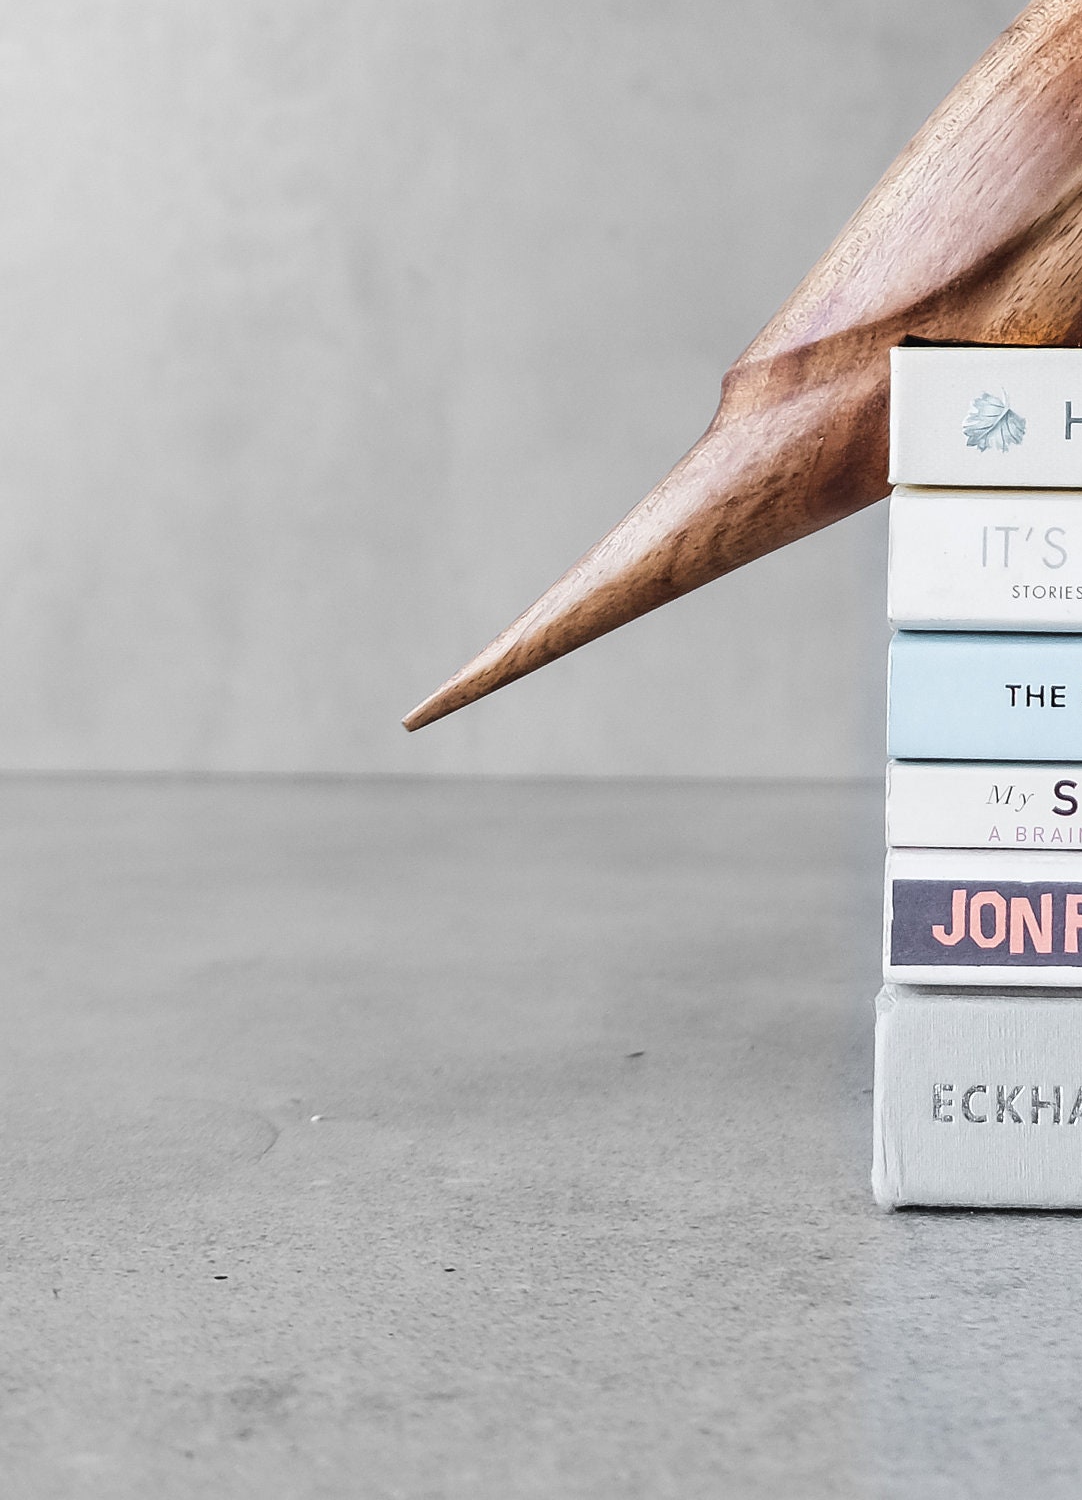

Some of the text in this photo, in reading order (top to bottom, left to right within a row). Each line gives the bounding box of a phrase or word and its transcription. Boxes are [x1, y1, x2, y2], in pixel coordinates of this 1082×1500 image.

[981, 525, 1069, 570] IT'S
[1005, 684, 1068, 709] THE
[986, 784, 1035, 813] My
[988, 826, 1001, 842] A
[931, 888, 1053, 955] JON
